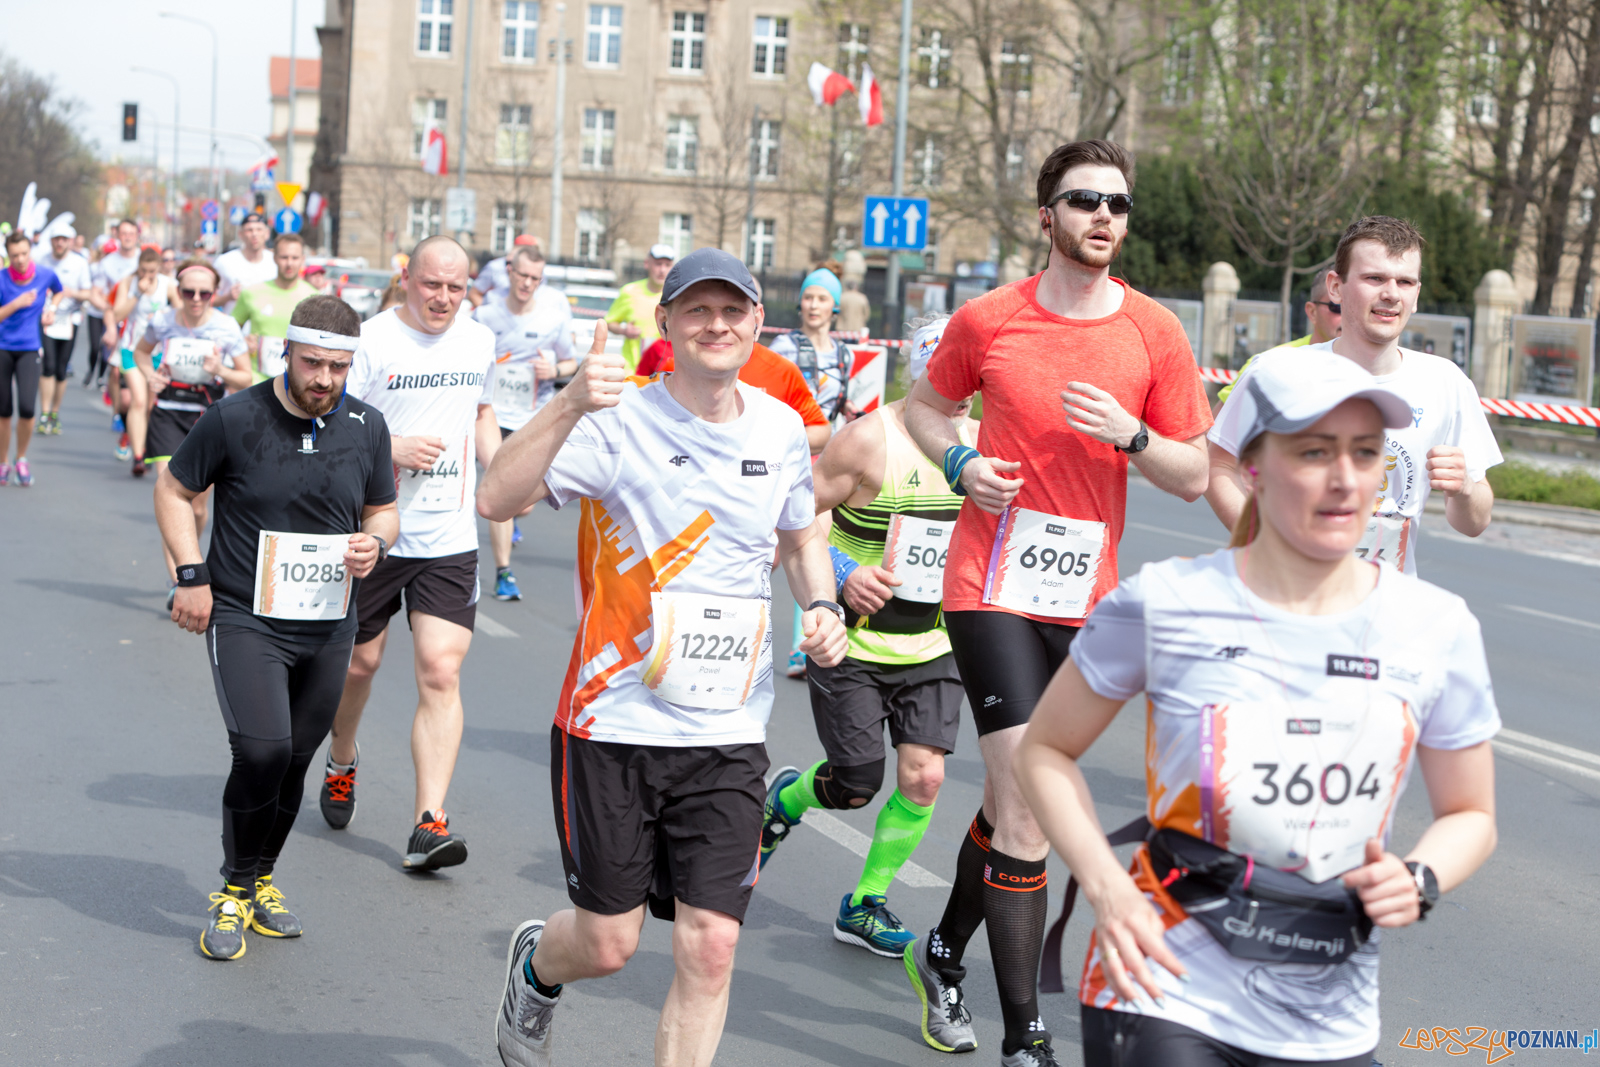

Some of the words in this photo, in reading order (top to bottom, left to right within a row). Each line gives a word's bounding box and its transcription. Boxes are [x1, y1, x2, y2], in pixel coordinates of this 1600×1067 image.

[280, 562, 344, 583] 10285
[1020, 544, 1091, 577] 6905
[1041, 578, 1064, 588] Adam
[681, 633, 748, 661] 12224
[1251, 762, 1380, 806] 3604
[1257, 925, 1346, 958] Kalenji
